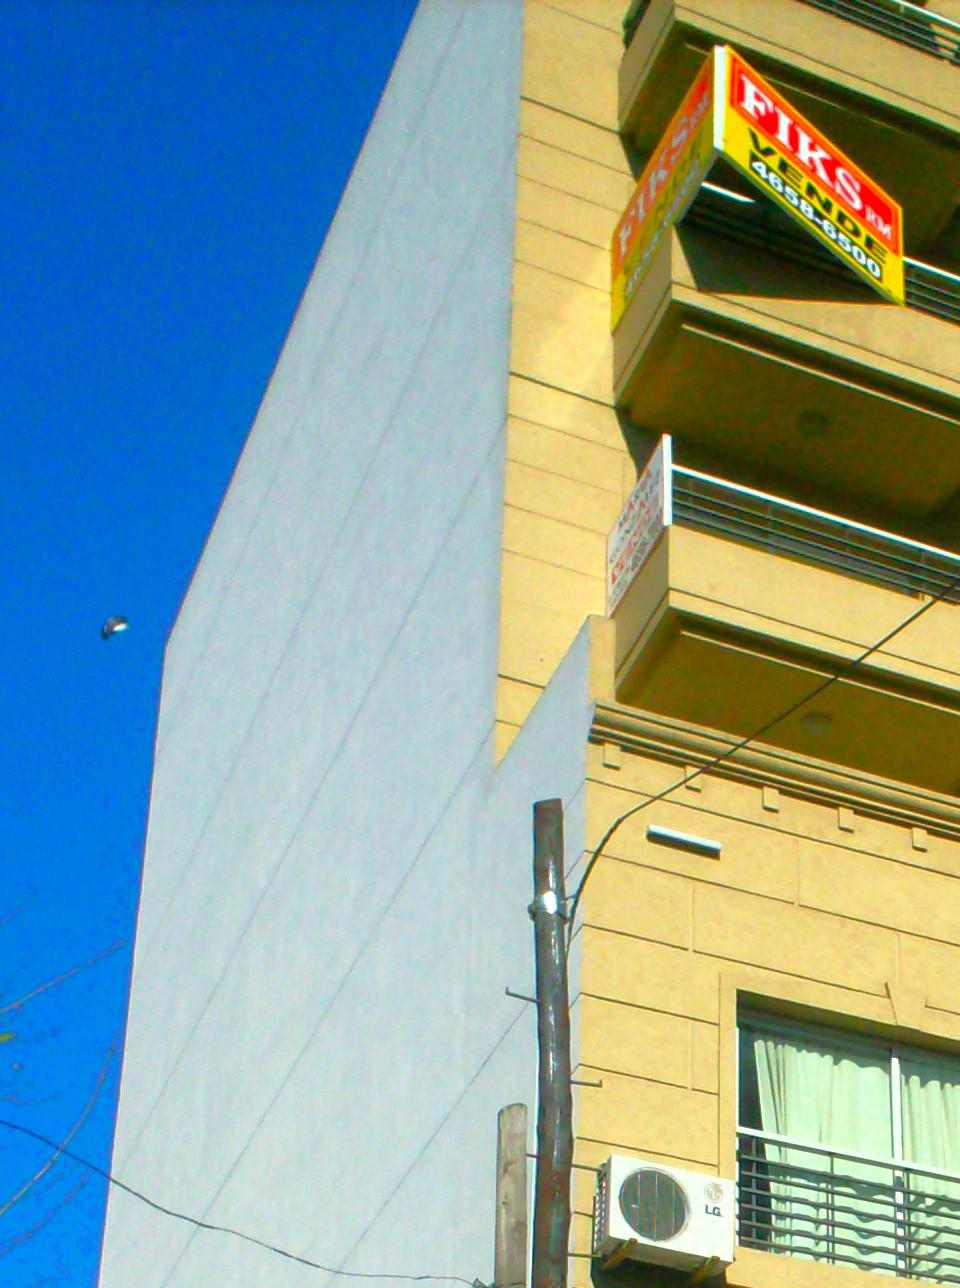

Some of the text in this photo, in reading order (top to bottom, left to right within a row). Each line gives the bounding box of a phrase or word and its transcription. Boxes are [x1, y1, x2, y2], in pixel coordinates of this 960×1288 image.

[740, 73, 862, 211] FIKS
[749, 127, 888, 264] VENDE
[751, 160, 882, 279] 4658-6500
[704, 1204, 722, 1217] LG
